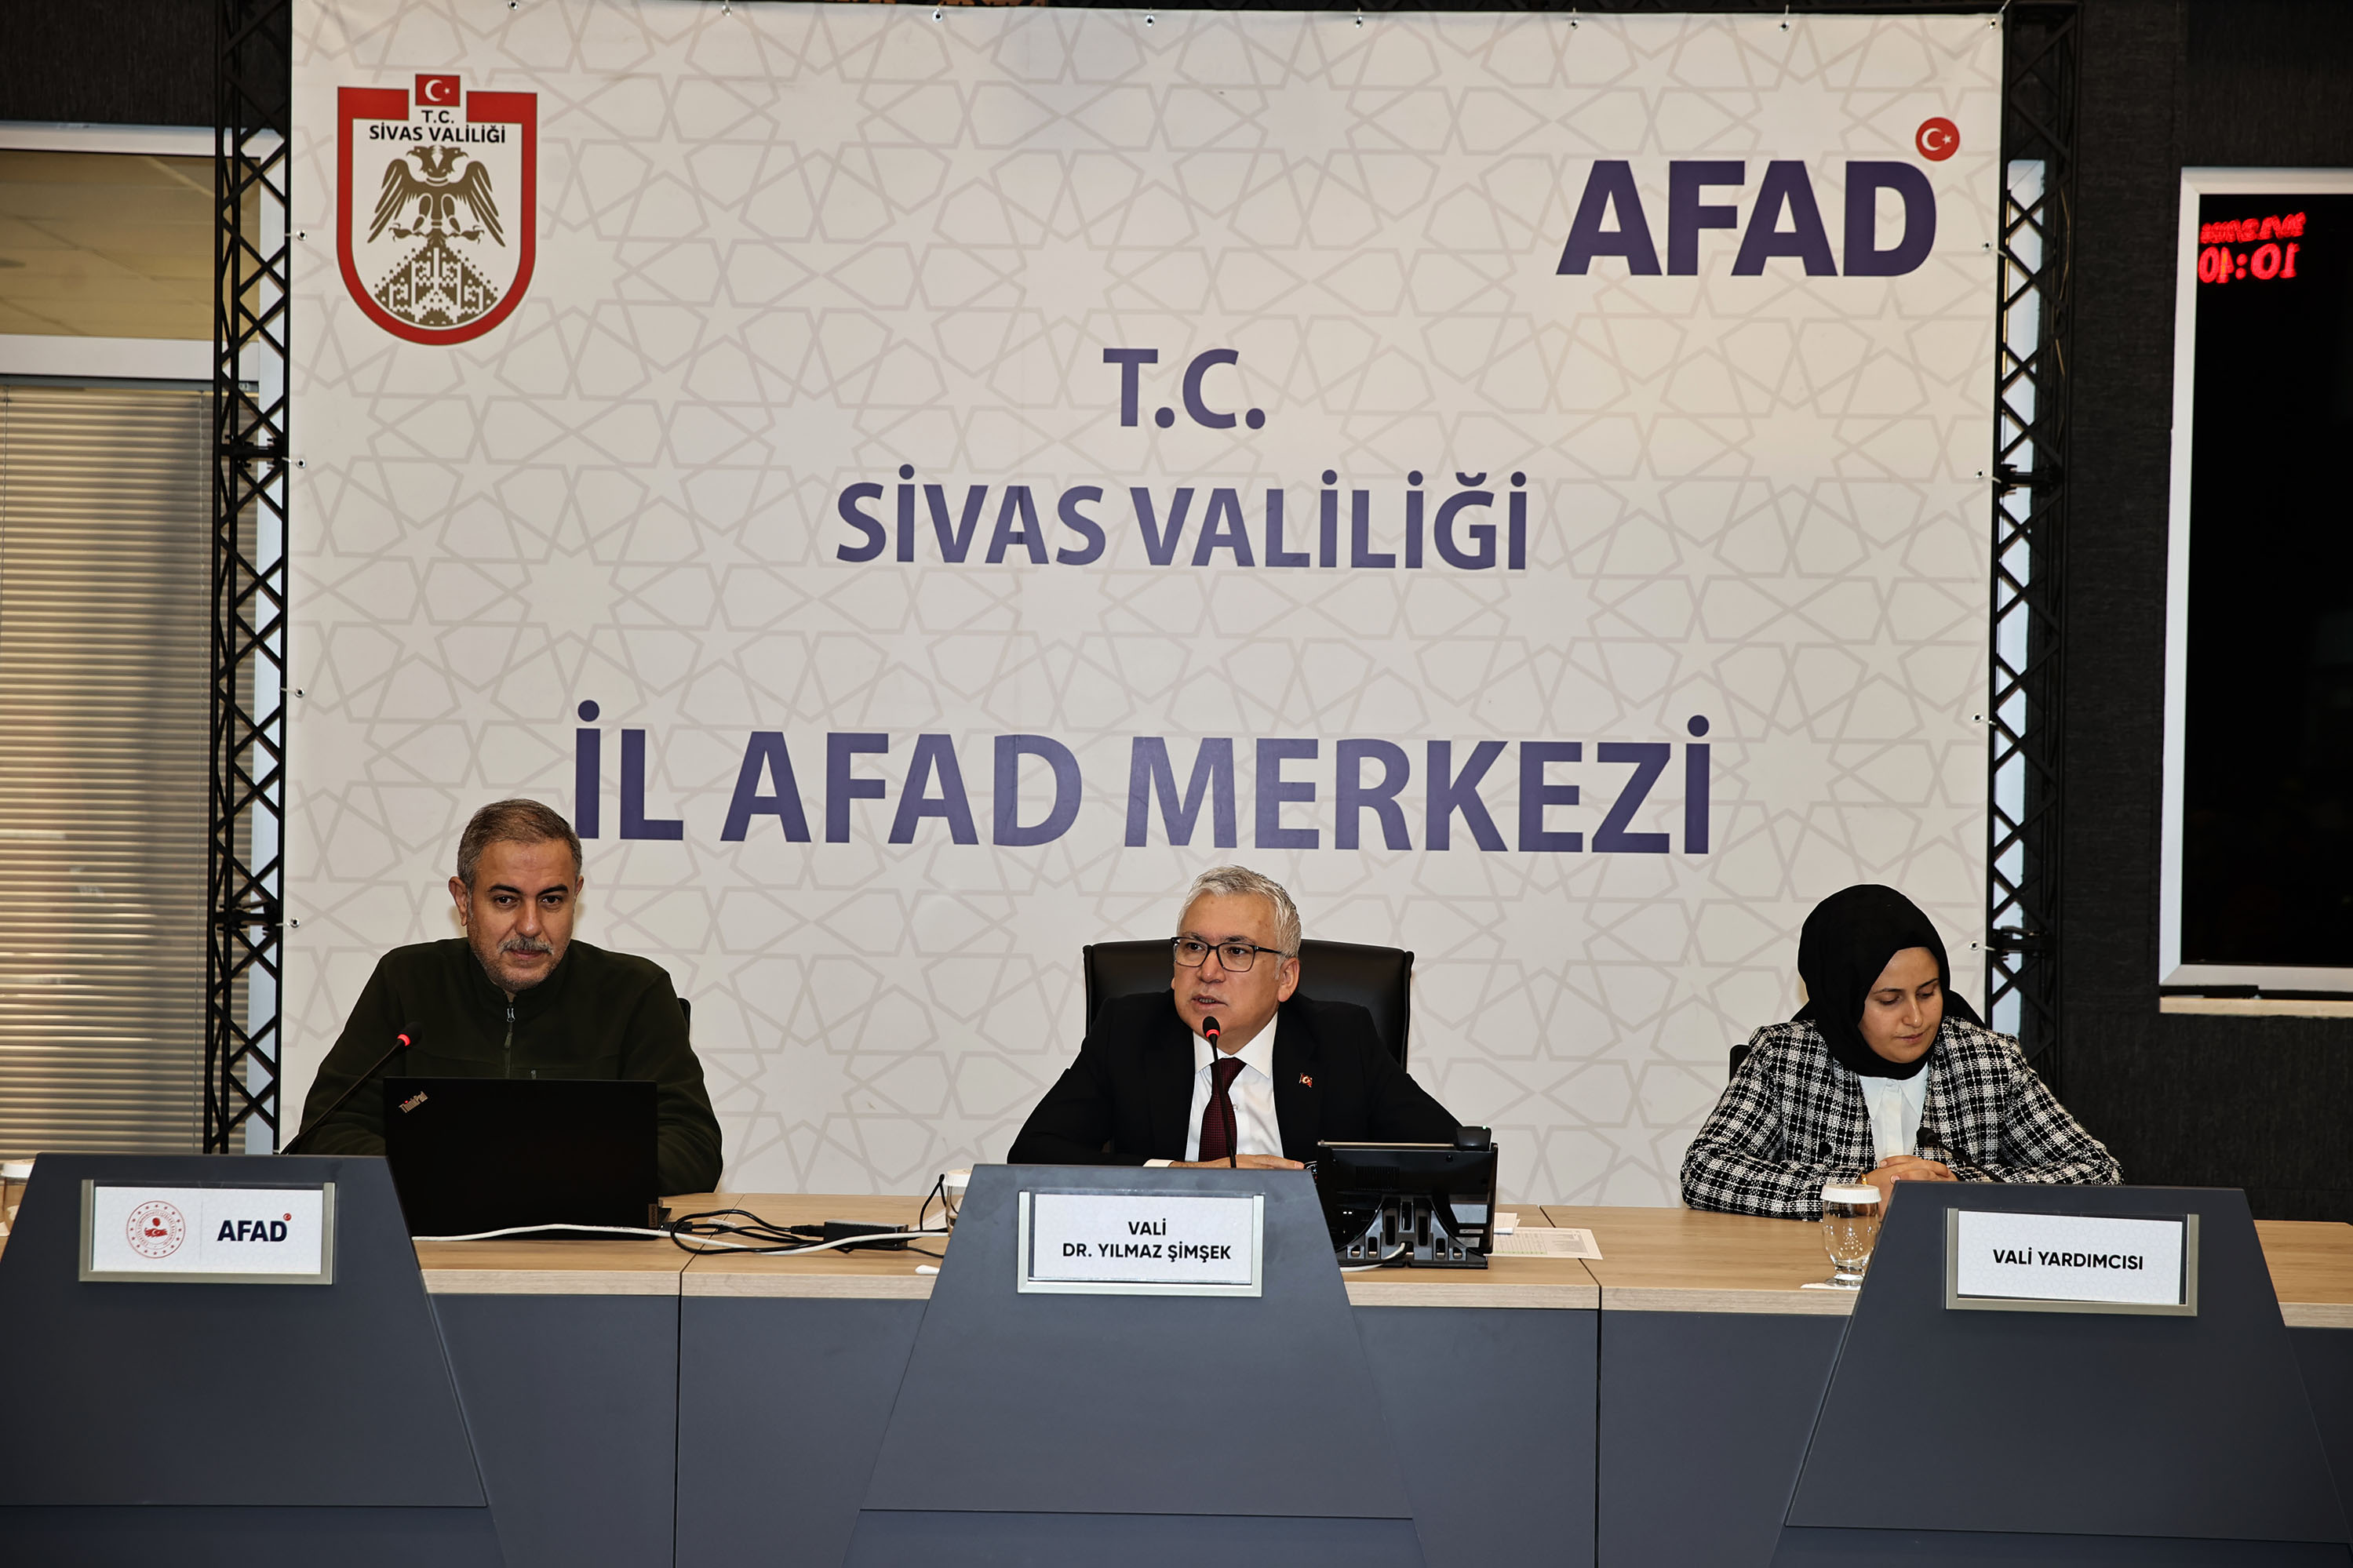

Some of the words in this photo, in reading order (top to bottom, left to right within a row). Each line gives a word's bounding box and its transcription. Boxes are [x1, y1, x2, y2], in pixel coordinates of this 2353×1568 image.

[421, 110, 454, 124] T.C.
[370, 122, 423, 141] SİVAS
[428, 125, 505, 144] VALİLİĞİ
[1556, 160, 1936, 277] AFAD
[1102, 347, 1266, 430] T.C.
[836, 464, 1106, 566] SİVAS
[1130, 470, 1527, 570] VALİLİĞİ
[574, 700, 684, 842] İL
[719, 730, 1082, 847] AFAD
[1124, 715, 1710, 855] MERKEZİ
[217, 1220, 289, 1242] AFAD
[1127, 1217, 1167, 1236] VALİ
[1062, 1242, 1092, 1257] DR.
[1098, 1243, 1163, 1259] YILMAZ
[1167, 1241, 1232, 1263] ŞİMŞEK
[1993, 1246, 2033, 1265] VALİ
[2038, 1250, 2144, 1270] YARDIMCISI
